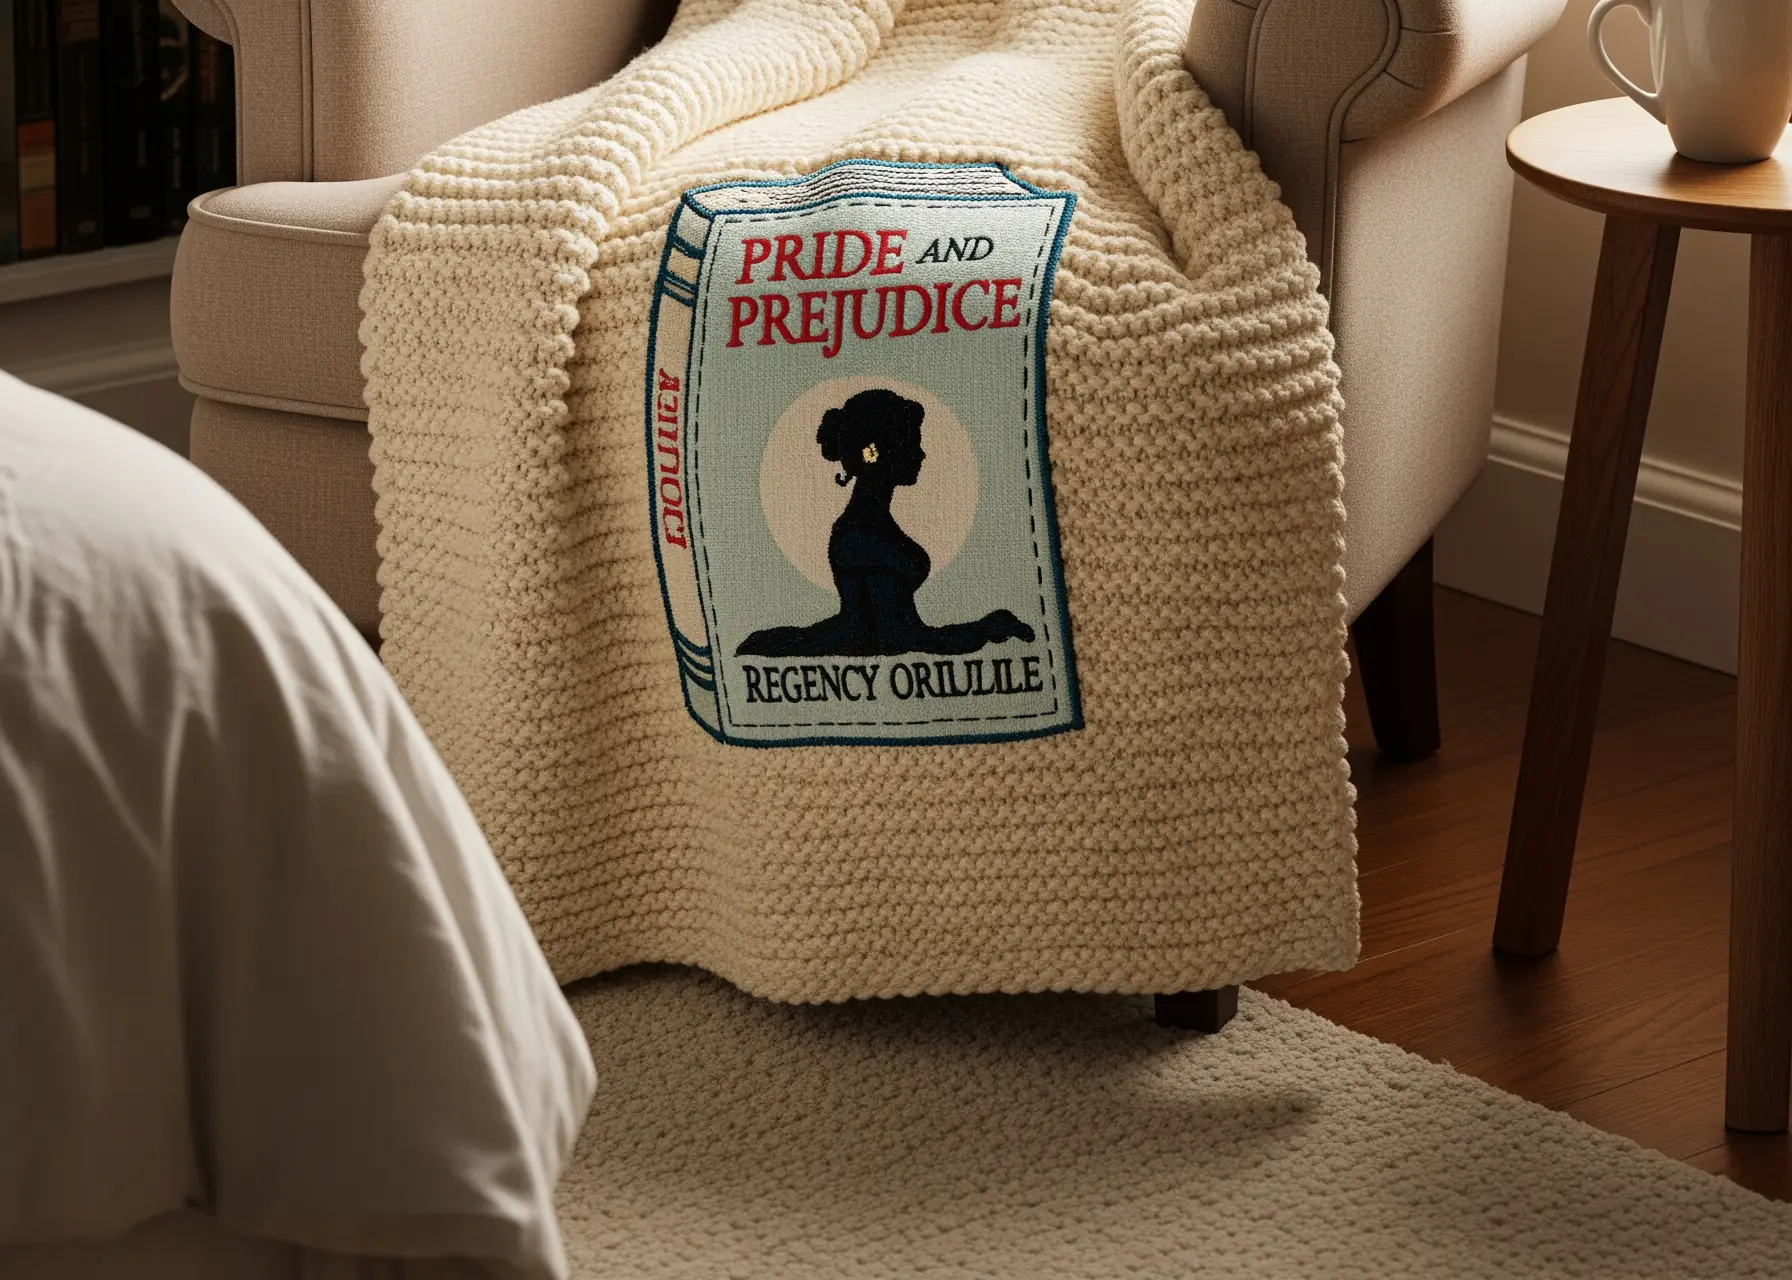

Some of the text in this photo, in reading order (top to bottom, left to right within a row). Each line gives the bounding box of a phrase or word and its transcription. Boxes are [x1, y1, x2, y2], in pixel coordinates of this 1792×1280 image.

[735, 229, 994, 284] PRIDE AND
[726, 278, 1023, 358] PREJUDICE
[742, 664, 881, 704] REGENCY
